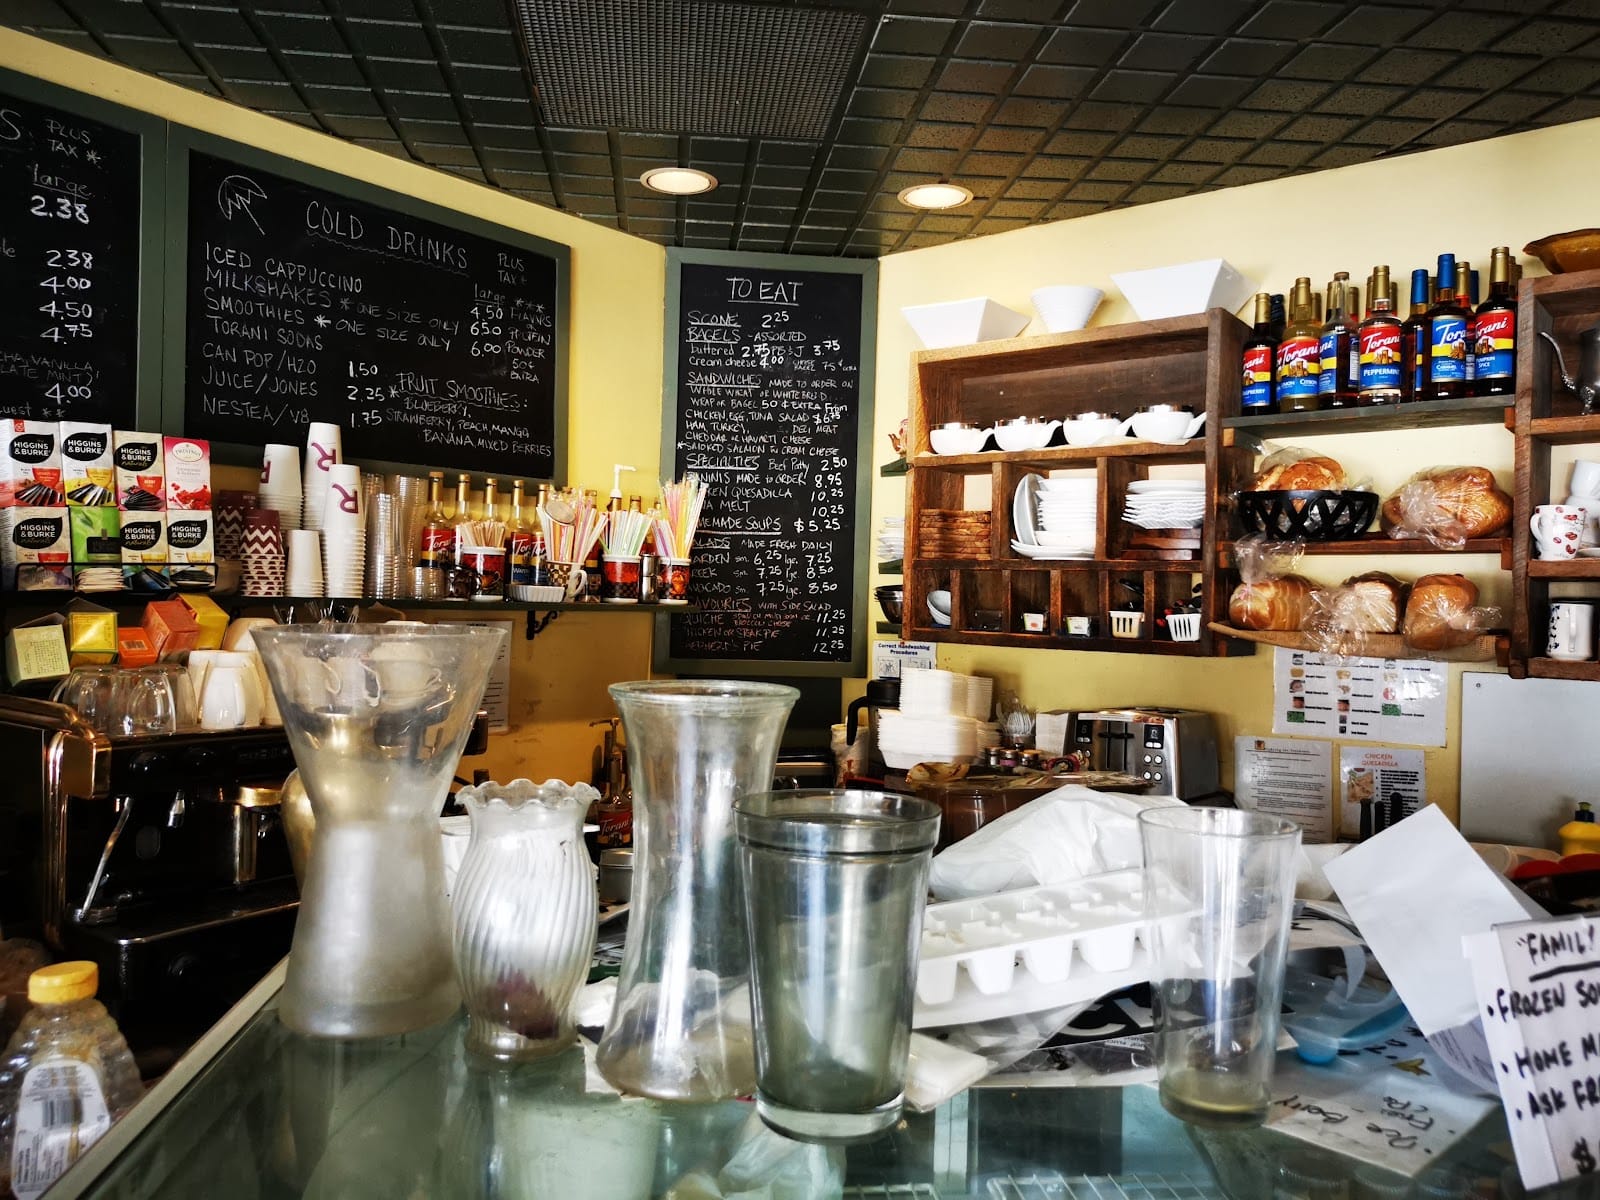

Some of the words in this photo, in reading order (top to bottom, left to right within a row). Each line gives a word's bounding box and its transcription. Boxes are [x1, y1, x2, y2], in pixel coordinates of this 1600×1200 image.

[45, 118, 92, 145] PLUS
[33, 163, 92, 204] large
[30, 195, 90, 225] 2.38
[305, 200, 364, 240] COLD
[386, 225, 468, 269] DRINKS
[46, 249, 94, 270] 2.38
[206, 241, 252, 269] ICED
[264, 257, 363, 294] CAPPUCCINO
[497, 252, 525, 272] PLUS
[39, 276, 92, 295] 4.00
[474, 282, 506, 306] large
[726, 276, 753, 300] TO
[759, 281, 804, 303] EAT
[205, 264, 332, 309] MILKSHAKES
[357, 303, 382, 318] ONE
[385, 309, 422, 324] SIZE
[428, 318, 460, 336] ONLY
[470, 304, 504, 322] 4.50
[39, 300, 93, 320] 4.50
[203, 286, 305, 325] SMOOTHIES
[335, 319, 367, 336] ONE
[376, 328, 408, 342] SIZE
[417, 335, 450, 351] ONLY
[470, 321, 502, 336] 6.50
[687, 309, 739, 326] SCONE
[761, 310, 790, 328] 2.25
[39, 323, 93, 345] 4.75
[206, 314, 268, 341] TORANI
[277, 327, 324, 351] SODAS
[470, 341, 502, 358] 6.00
[686, 326, 742, 342] BAGELS
[504, 339, 546, 359] POWDER
[690, 343, 735, 356] buttered
[741, 342, 771, 358] 2.75
[812, 340, 841, 356] 3.75
[1281, 342, 1319, 365] Torani
[31, 354, 93, 370] VANILLA
[202, 342, 238, 363] CAN
[348, 360, 378, 378] 1.50
[688, 356, 723, 368] Cream
[724, 356, 758, 368] cheese
[759, 355, 785, 369] 4.00
[396, 372, 439, 395] FRUIT
[687, 372, 763, 386] SANDWICHES
[768, 379, 793, 388] MADE
[796, 380, 808, 388] TO
[810, 379, 838, 388] ORDER
[841, 380, 854, 389] ON
[44, 383, 92, 405] 4.00
[346, 385, 386, 402] 2.25
[690, 386, 722, 397] WHOLE
[772, 389, 800, 400] WHITE
[690, 397, 715, 408] WRAP
[730, 399, 759, 409] BAGEL
[824, 402, 849, 414] From
[351, 409, 382, 428] 1.75
[748, 412, 774, 422] TUNA
[777, 412, 810, 423] SALAD
[811, 412, 841, 425] $6.75
[685, 431, 728, 443] CHEDDAR
[781, 434, 814, 445] CHEESE
[815, 424, 839, 435] MEAT
[14, 441, 49, 451] HIGGINS
[22, 448, 49, 457] BURKE
[67, 439, 102, 449] HIGGINS
[75, 446, 102, 454] BURKE
[120, 447, 152, 456] HIGGINS
[512, 442, 552, 457] BERRIES
[727, 443, 766, 454] SALMON
[809, 447, 840, 457] CHEESE
[127, 453, 153, 463] BURKE
[686, 452, 761, 469] SPECIALTIES
[820, 457, 848, 472] 2.50
[736, 473, 762, 484] MADE
[775, 473, 807, 486] ORDER
[814, 474, 843, 489] 8.95
[731, 487, 793, 499] QUESADILLA
[810, 488, 844, 503] 10.25
[719, 500, 752, 513] MELT
[811, 504, 845, 518] 10.25
[20, 524, 56, 533] HIGGINS
[124, 527, 156, 536] HIGGINS
[171, 525, 202, 535] HIGGINS
[744, 516, 783, 532] SOUPS
[793, 517, 841, 534] $5.25
[27, 531, 56, 539] BURKE
[130, 533, 156, 541] BURKE
[177, 531, 202, 540] BURKE
[741, 539, 766, 549] MADE
[769, 539, 798, 550] FRESH
[801, 540, 833, 553] DAILY
[753, 550, 783, 566] 6.25
[805, 553, 832, 567] 7.25
[757, 565, 783, 579] 7.25
[806, 566, 834, 579] 8.50
[756, 581, 785, 597] 7.25
[808, 582, 839, 595] 8.50
[758, 601, 778, 611] WITH
[781, 600, 802, 611] SIDE
[803, 600, 832, 611] SALAD
[816, 609, 846, 624] 11.25
[764, 628, 781, 638] PIE
[815, 625, 845, 638] 11.25
[743, 640, 764, 652] PIE
[812, 639, 845, 655] 12.25
[1496, 981, 1566, 1023] FROZEN
[1515, 1041, 1573, 1079] HOME
[1528, 1086, 1567, 1120] ASK
